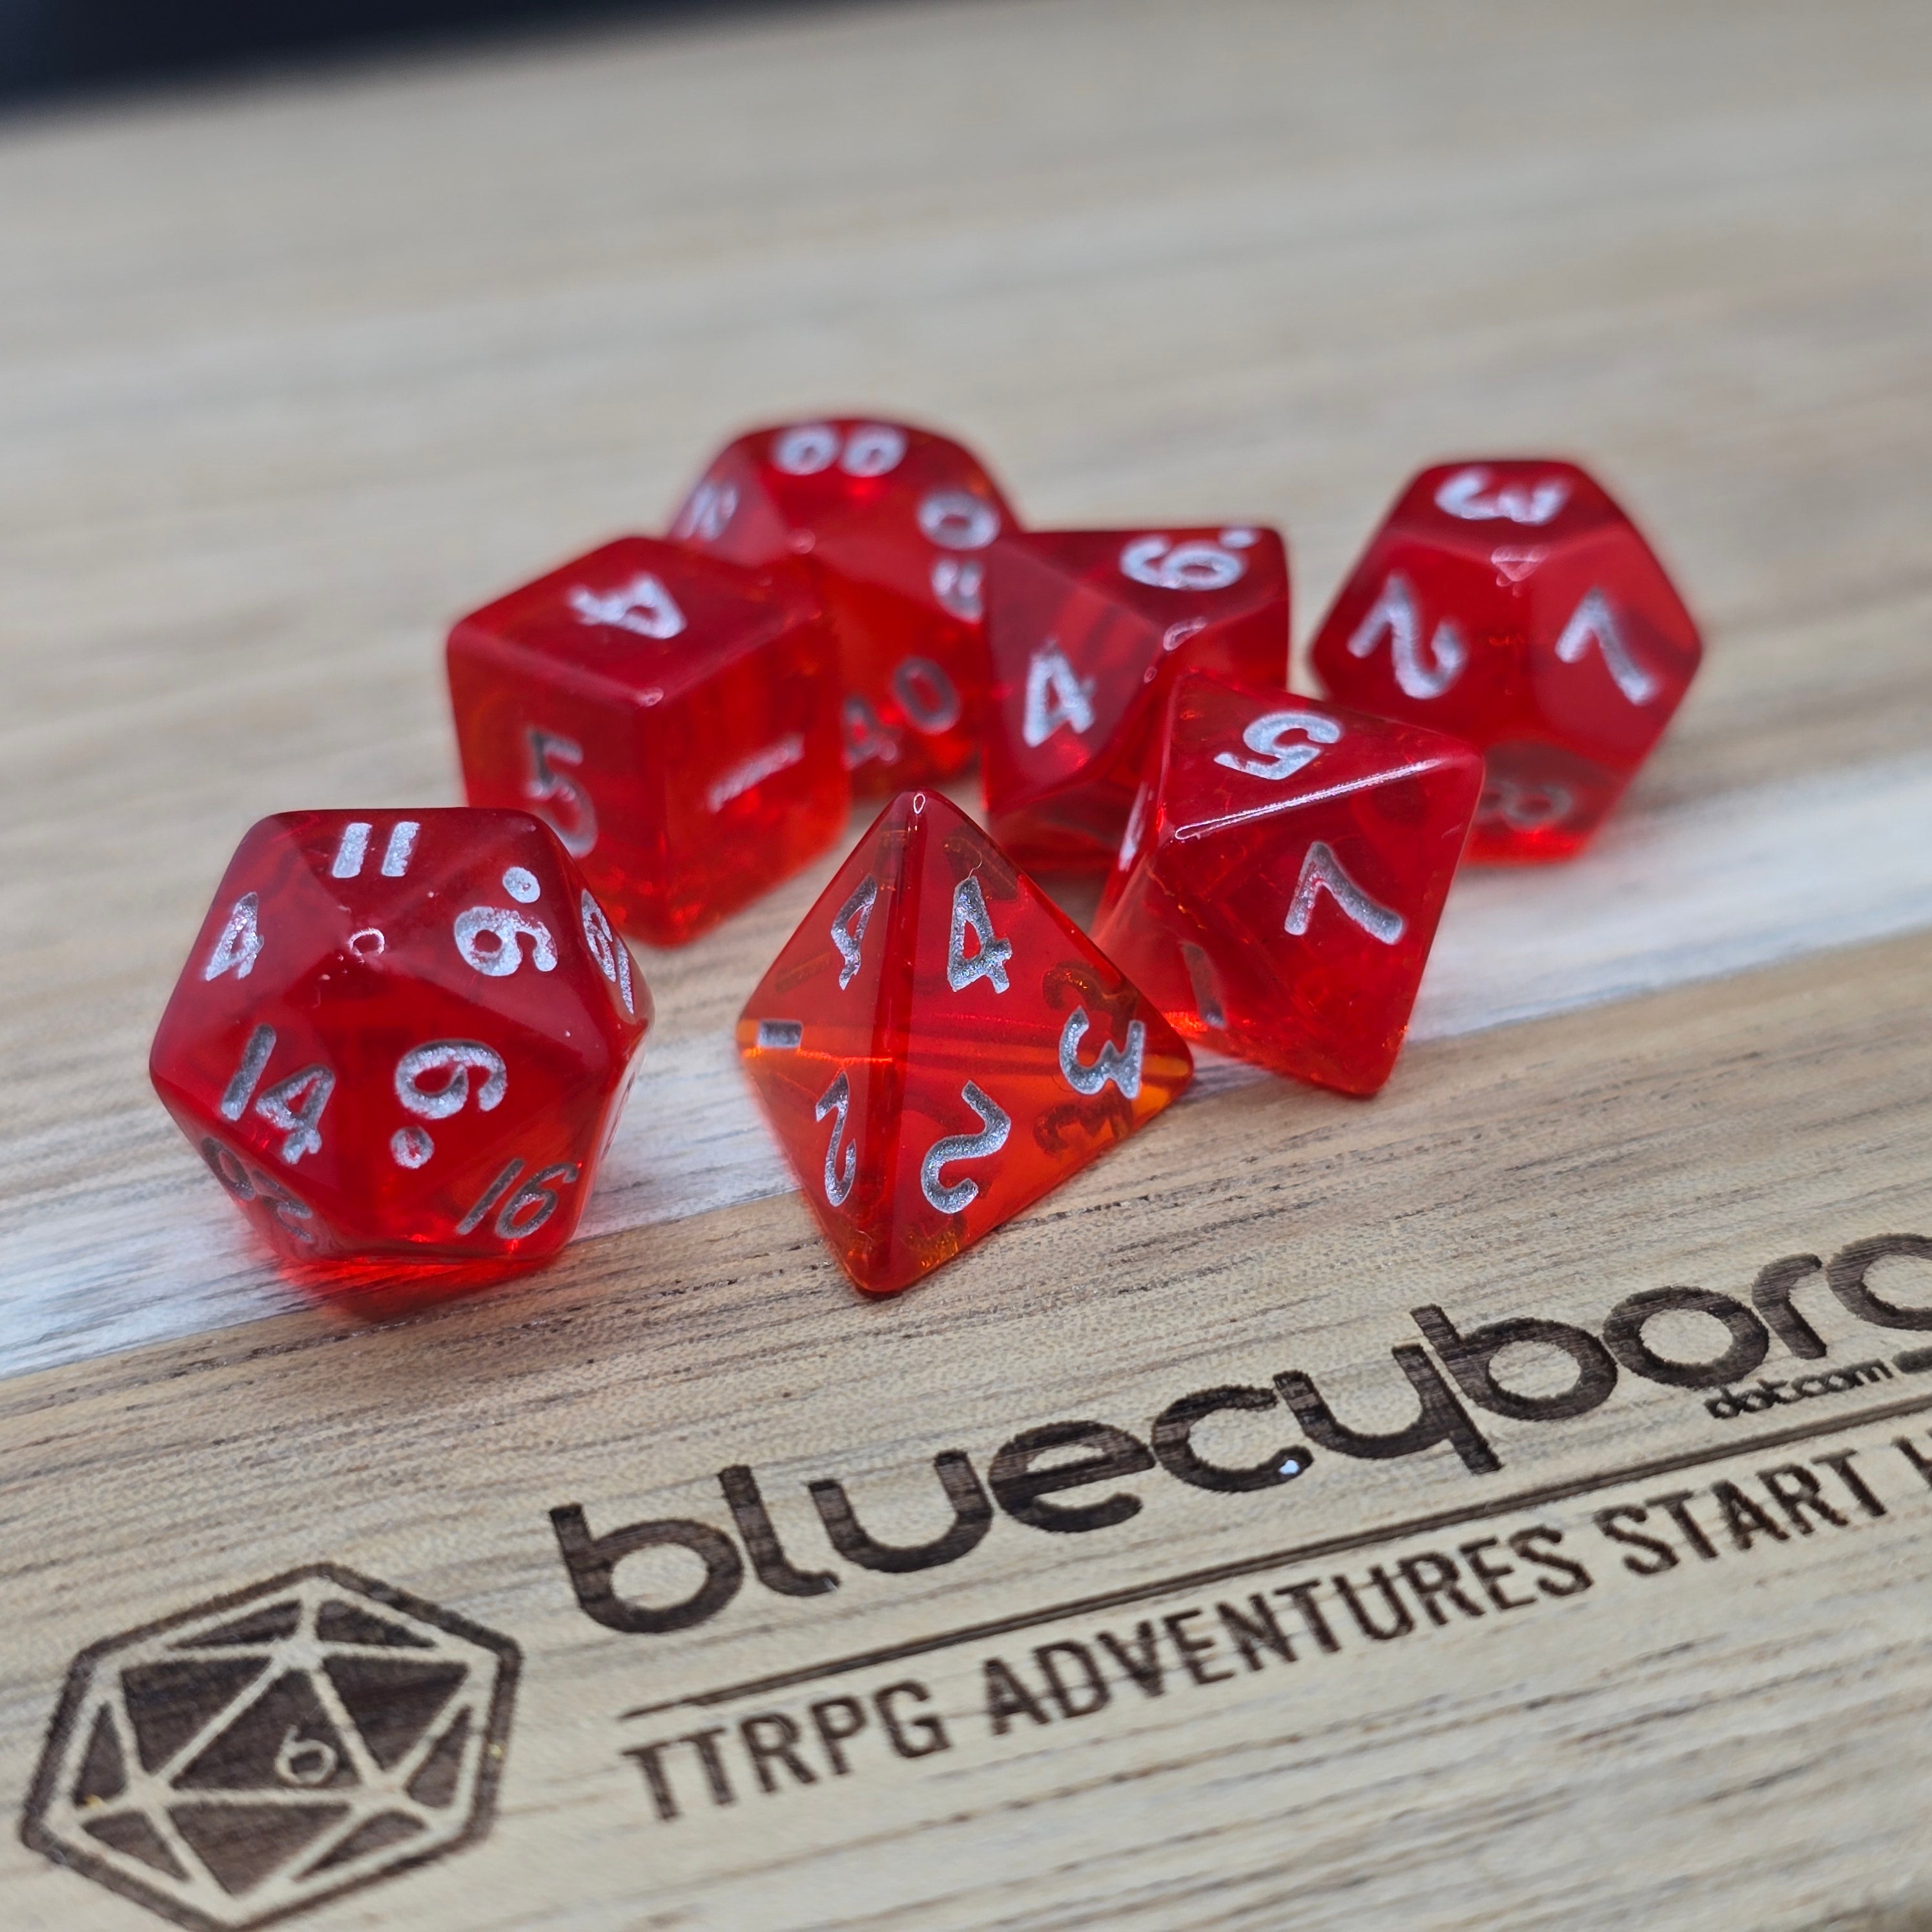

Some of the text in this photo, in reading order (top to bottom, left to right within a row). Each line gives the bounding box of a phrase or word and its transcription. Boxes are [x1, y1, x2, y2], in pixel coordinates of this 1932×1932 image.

[571, 573, 686, 639] 4
[1347, 575, 1464, 700] 2
[1023, 641, 1095, 747] 4
[1213, 710, 1342, 780] 5
[527, 728, 598, 858] 5
[332, 821, 420, 878] 11
[1284, 841, 1403, 945] 7
[205, 892, 264, 981] 4
[947, 876, 1012, 993] 4
[220, 1024, 336, 1164] 14
[1060, 1005, 1145, 1100] 3
[921, 1080, 1011, 1213] 2
[456, 1158, 579, 1240] 16
[1703, 1358, 1894, 1419] dotcom
[621, 1681, 951, 1821] TTRPG
[981, 1525, 1592, 1736] ADVENTURES
[1592, 1446, 1886, 1577] START
